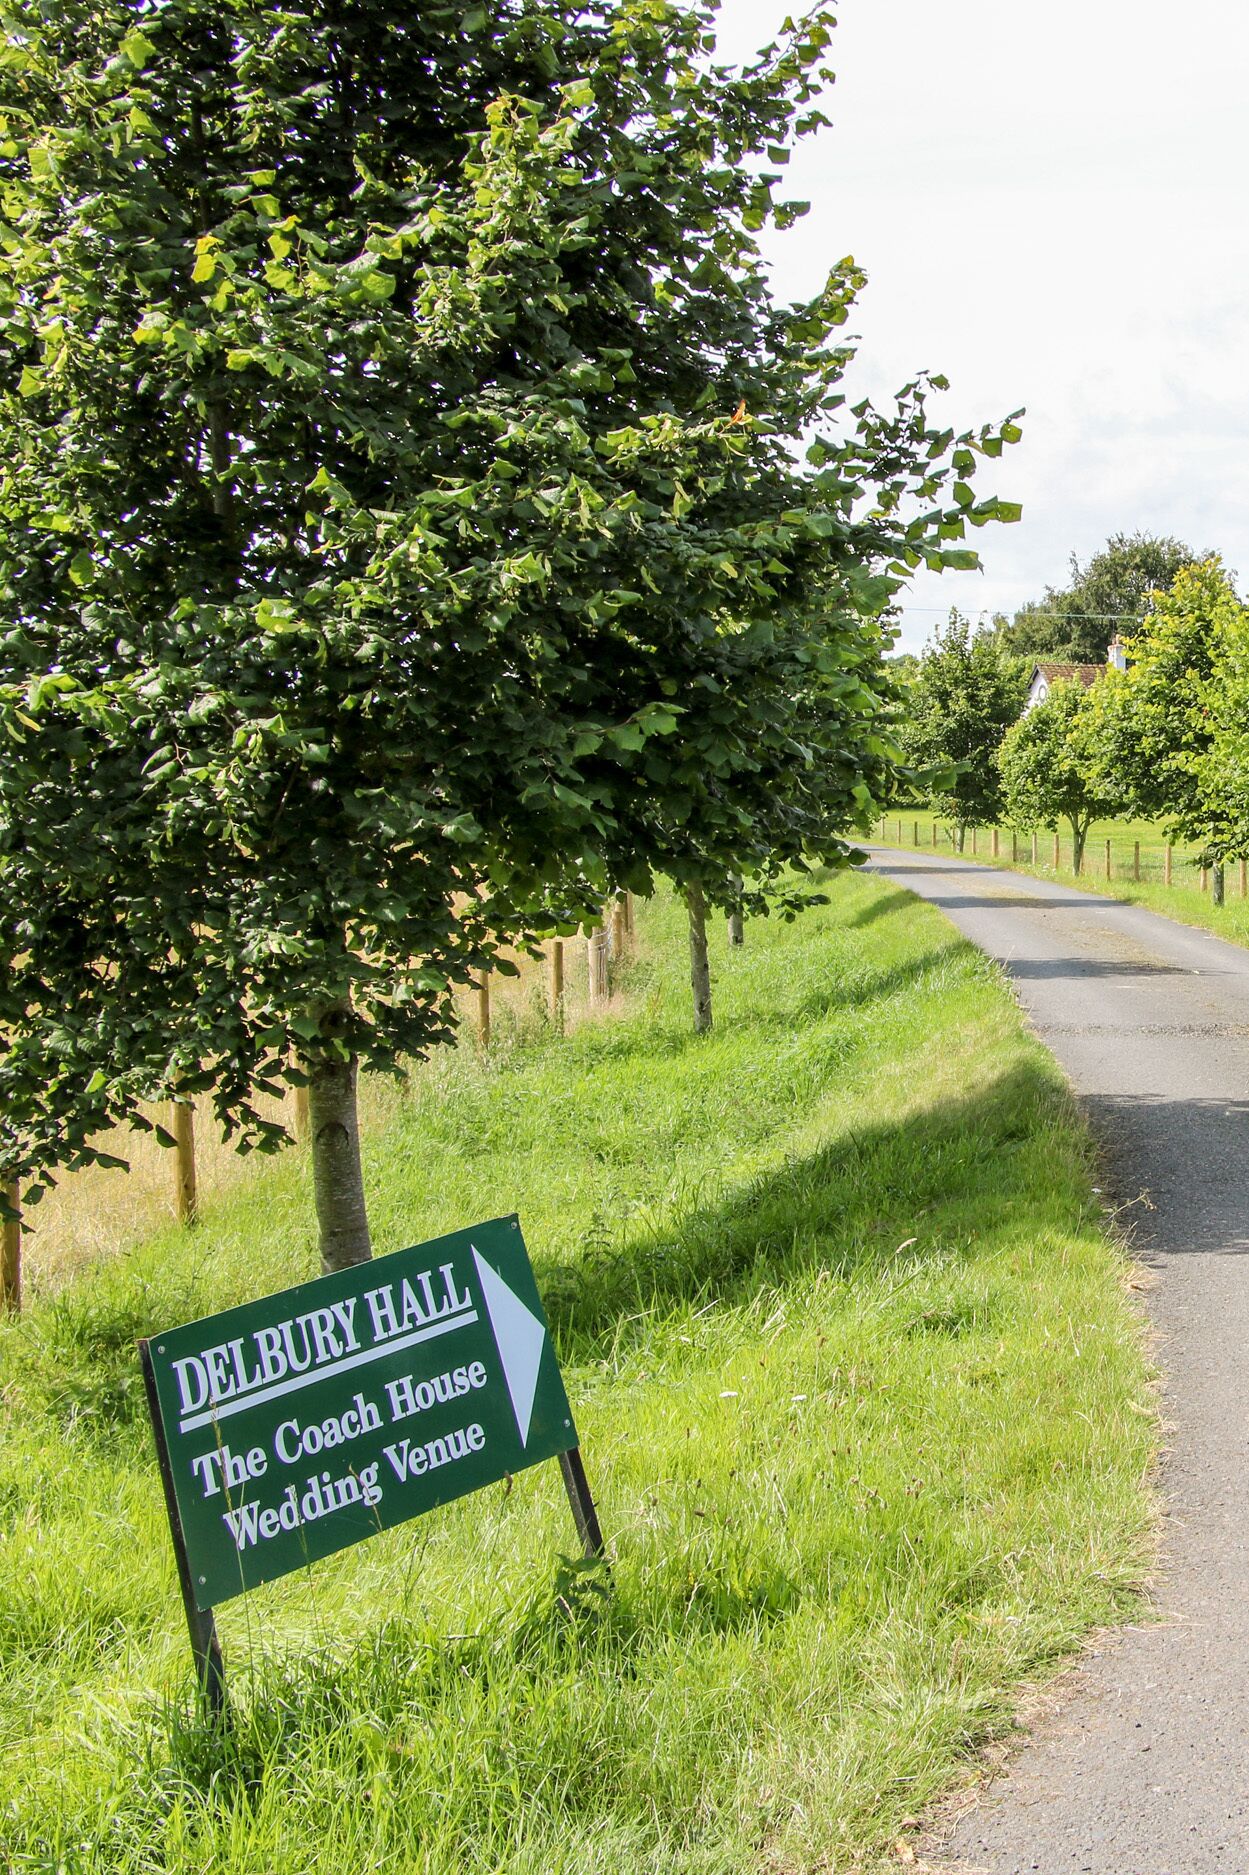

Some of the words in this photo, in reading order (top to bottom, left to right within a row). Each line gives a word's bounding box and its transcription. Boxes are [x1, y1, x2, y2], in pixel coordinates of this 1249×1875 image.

[172, 1297, 361, 1415] DELBURY
[363, 1262, 473, 1342] HALL
[192, 1445, 268, 1498] The
[274, 1392, 384, 1464] Coach
[384, 1360, 488, 1421] House
[222, 1461, 383, 1551] Wedding
[382, 1422, 486, 1482] Venue
